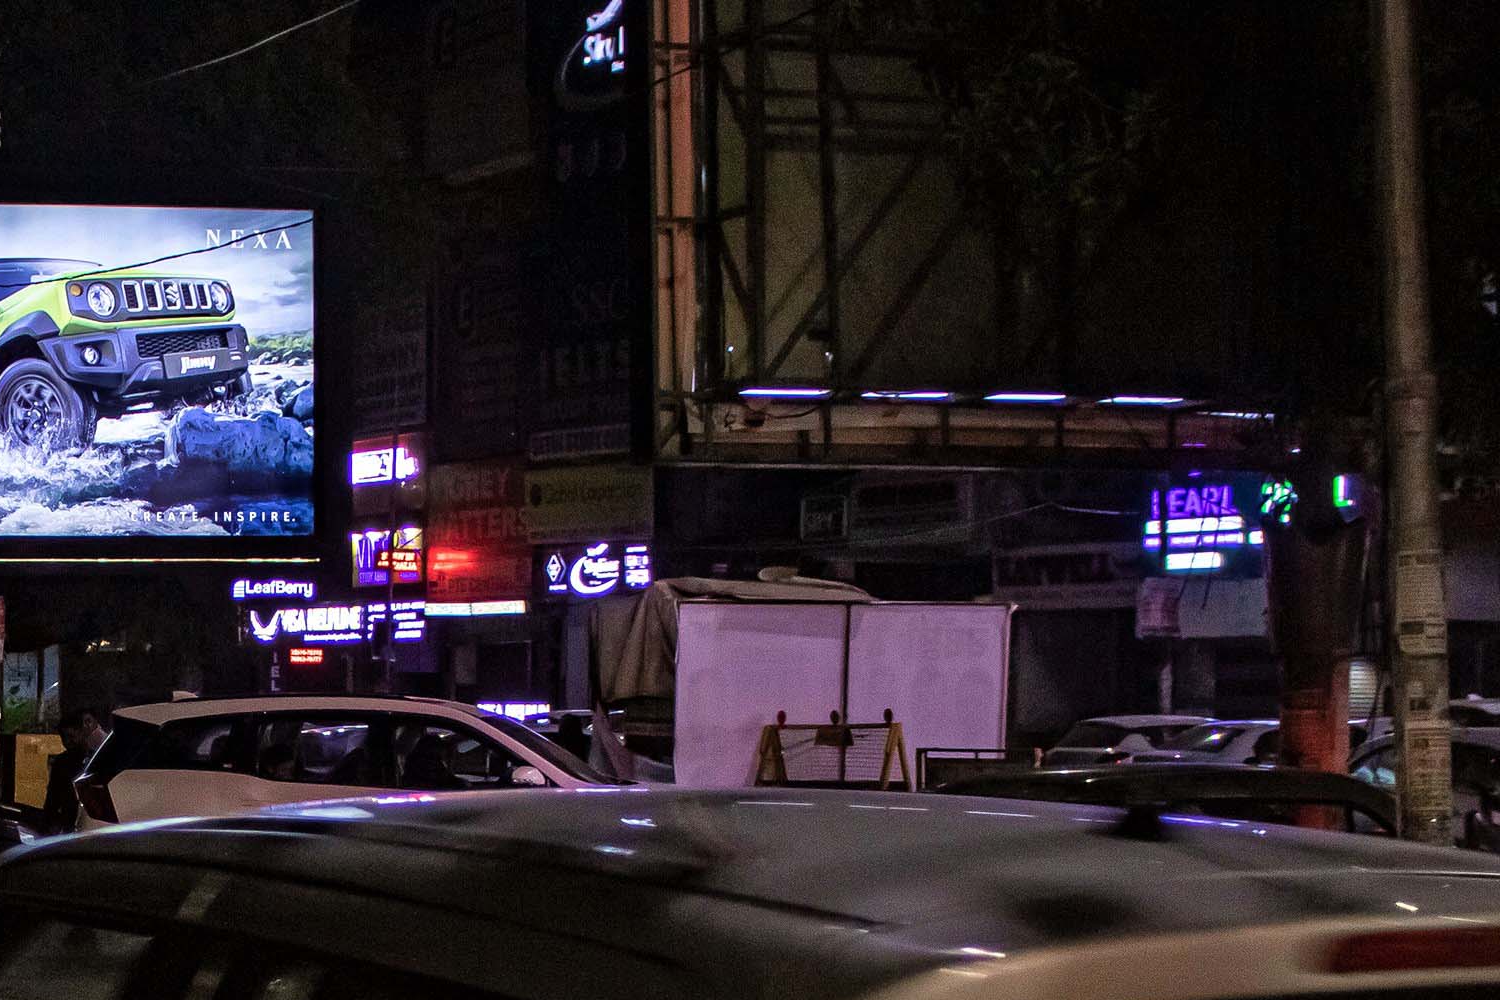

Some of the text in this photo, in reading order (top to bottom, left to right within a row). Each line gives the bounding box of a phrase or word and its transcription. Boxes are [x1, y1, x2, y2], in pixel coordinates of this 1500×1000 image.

[206, 228, 292, 250] NEXA
[214, 511, 296, 522] INSPIRE.
[245, 580, 313, 598] LeafBerry
